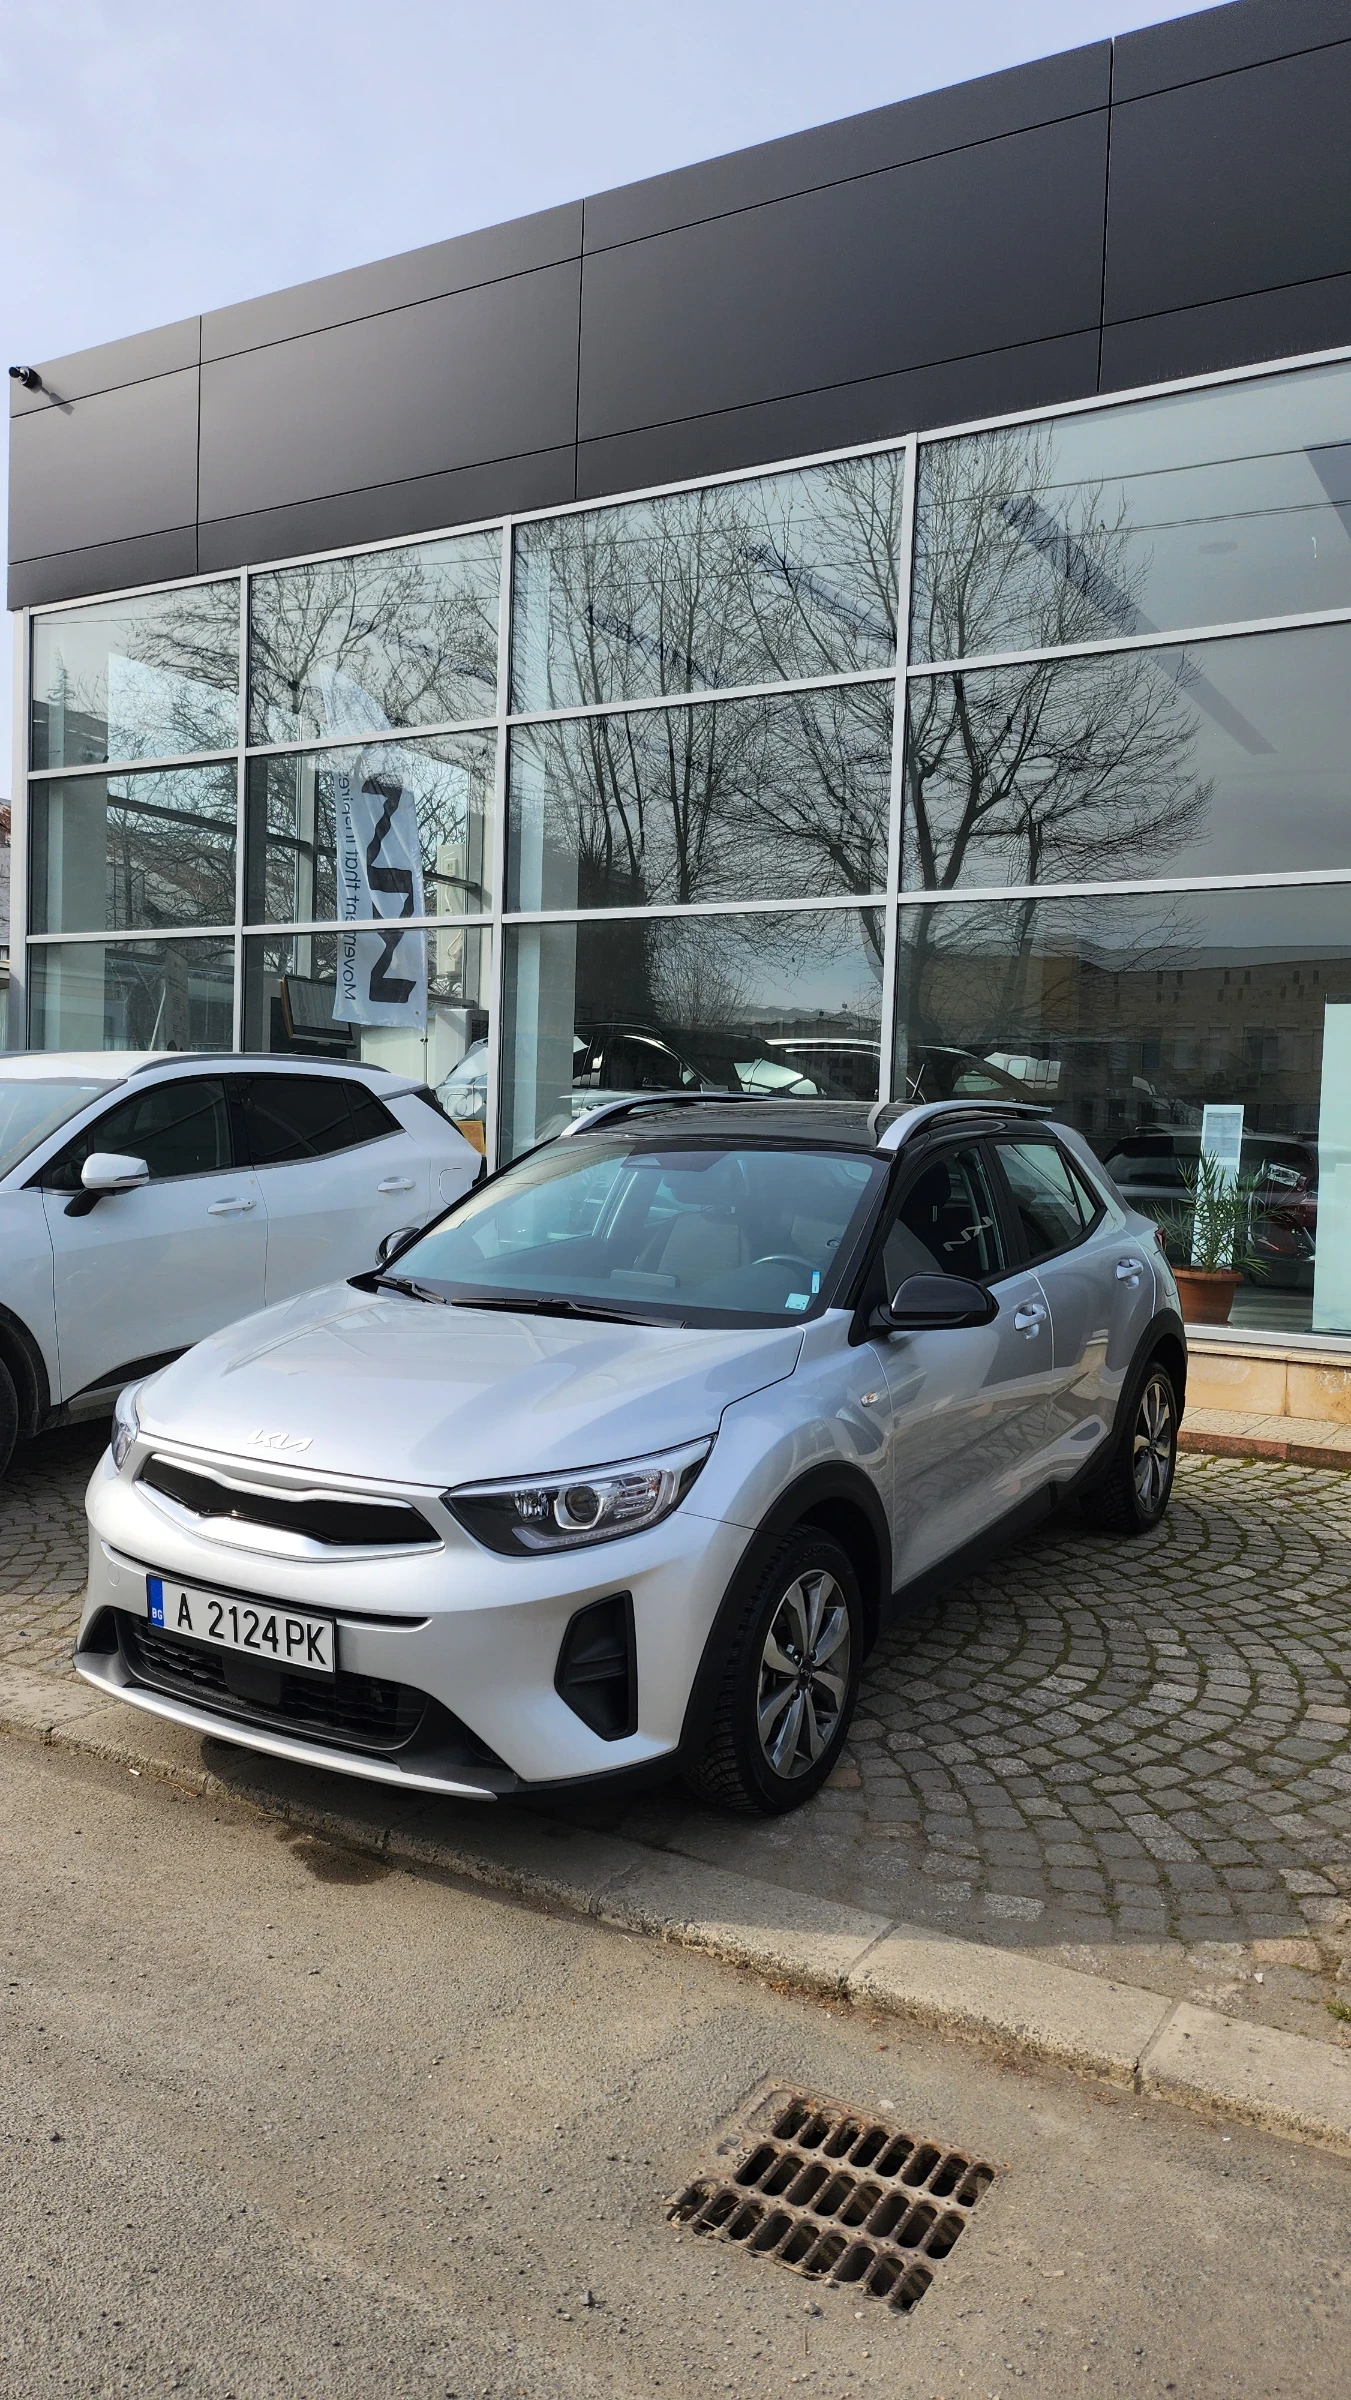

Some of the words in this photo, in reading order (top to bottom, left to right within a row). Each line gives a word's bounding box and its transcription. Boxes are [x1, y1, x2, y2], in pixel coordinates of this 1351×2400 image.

[246, 1429, 314, 1453] KIA
[152, 1607, 163, 1620] BG
[177, 1592, 193, 1631] A
[732, 2147, 752, 2168] ACO
